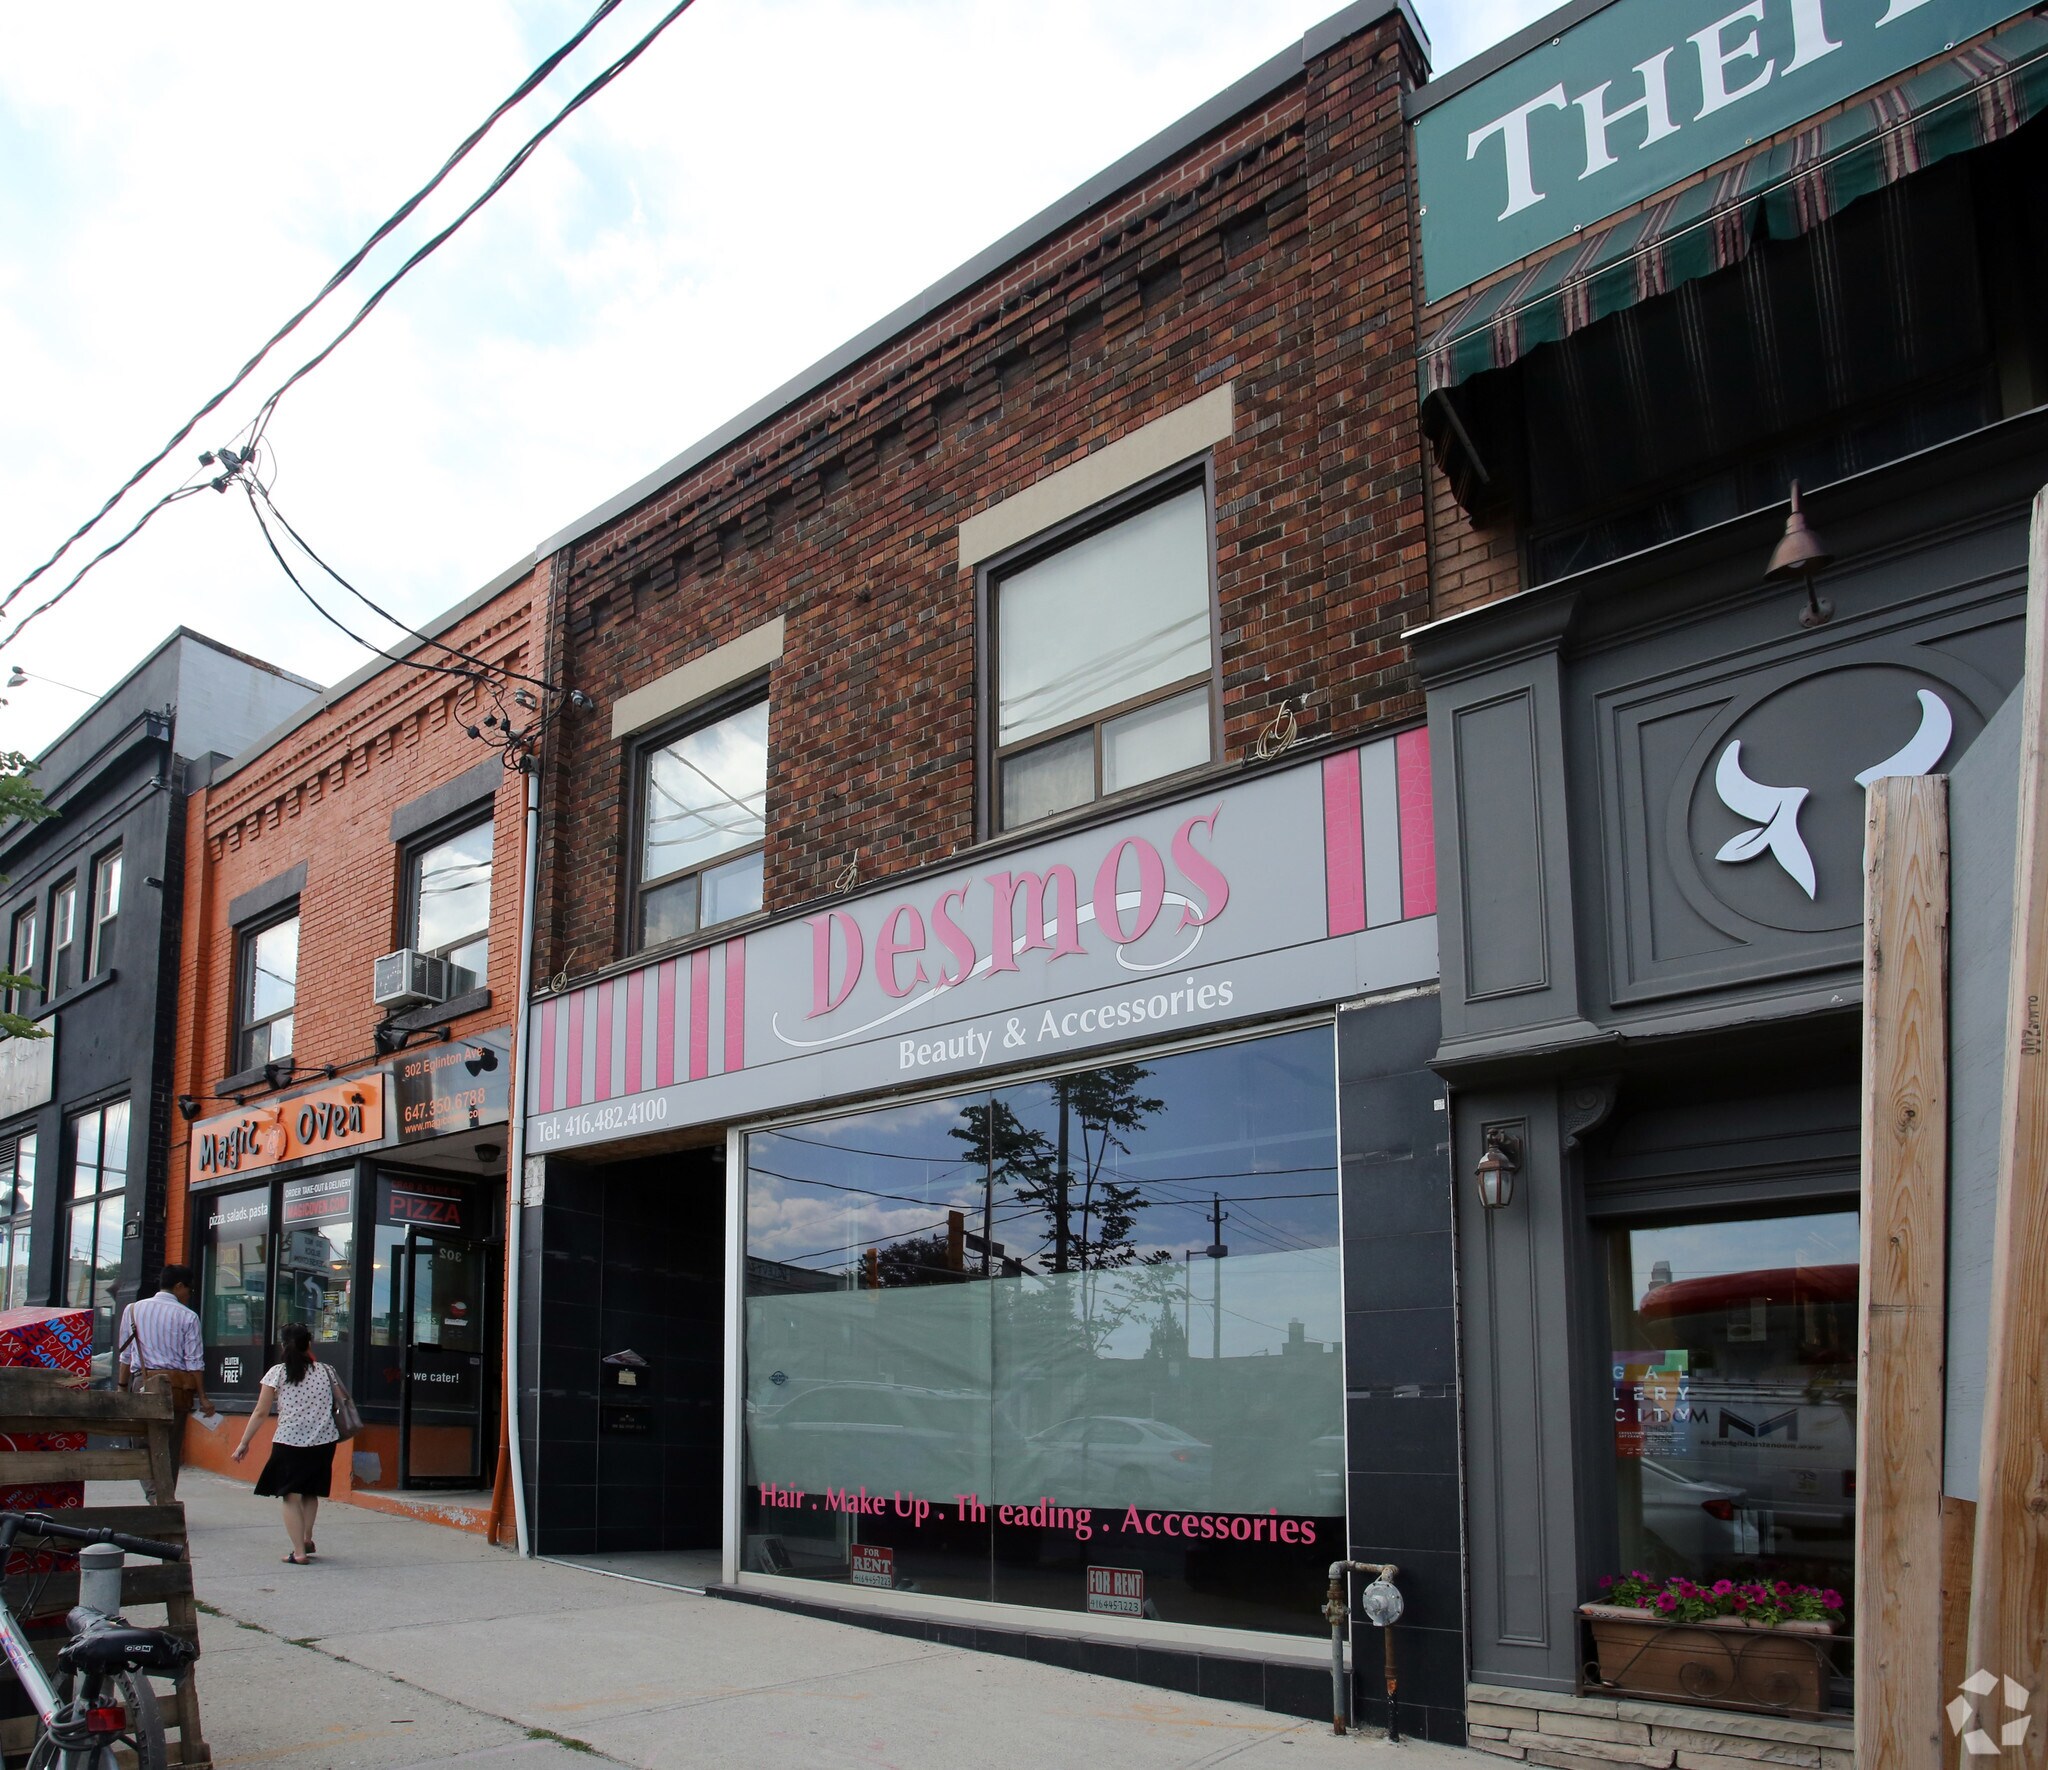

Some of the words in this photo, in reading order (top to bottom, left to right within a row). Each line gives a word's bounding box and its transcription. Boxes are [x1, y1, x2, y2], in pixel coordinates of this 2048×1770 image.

[899, 1026, 993, 1064] Beauty
[1003, 1017, 1026, 1049] &
[1036, 976, 1234, 1042] Accessories
[404, 1062, 422, 1078] 302
[423, 1051, 462, 1074] Eglinton
[404, 1087, 486, 1122] 647.350.6788
[538, 1117, 561, 1142] Tel:
[565, 1097, 668, 1137] 416.482.4100
[199, 1118, 261, 1173] Magic
[296, 1101, 364, 1145] Oven
[285, 1186, 302, 1199] ORDER
[302, 1182, 325, 1196] TAKE-OUT
[328, 1177, 352, 1191] DELIVERY
[248, 1202, 268, 1221] pasta
[389, 1194, 462, 1225] PIZZA
[44, 1318, 84, 1352] M6S
[224, 1357, 240, 1366] GLUTEN
[223, 1369, 239, 1383] FREE
[413, 1372, 428, 1381] we
[430, 1373, 460, 1384] cater!
[760, 1482, 804, 1510] Hair
[825, 1485, 886, 1516] Make
[894, 1491, 930, 1527] Up
[1120, 1503, 1317, 1545] Accessories
[852, 1556, 891, 1574] RENT
[863, 1547, 880, 1558] FOR
[1089, 1570, 1111, 1594] FOR
[1114, 1572, 1142, 1597] RENT
